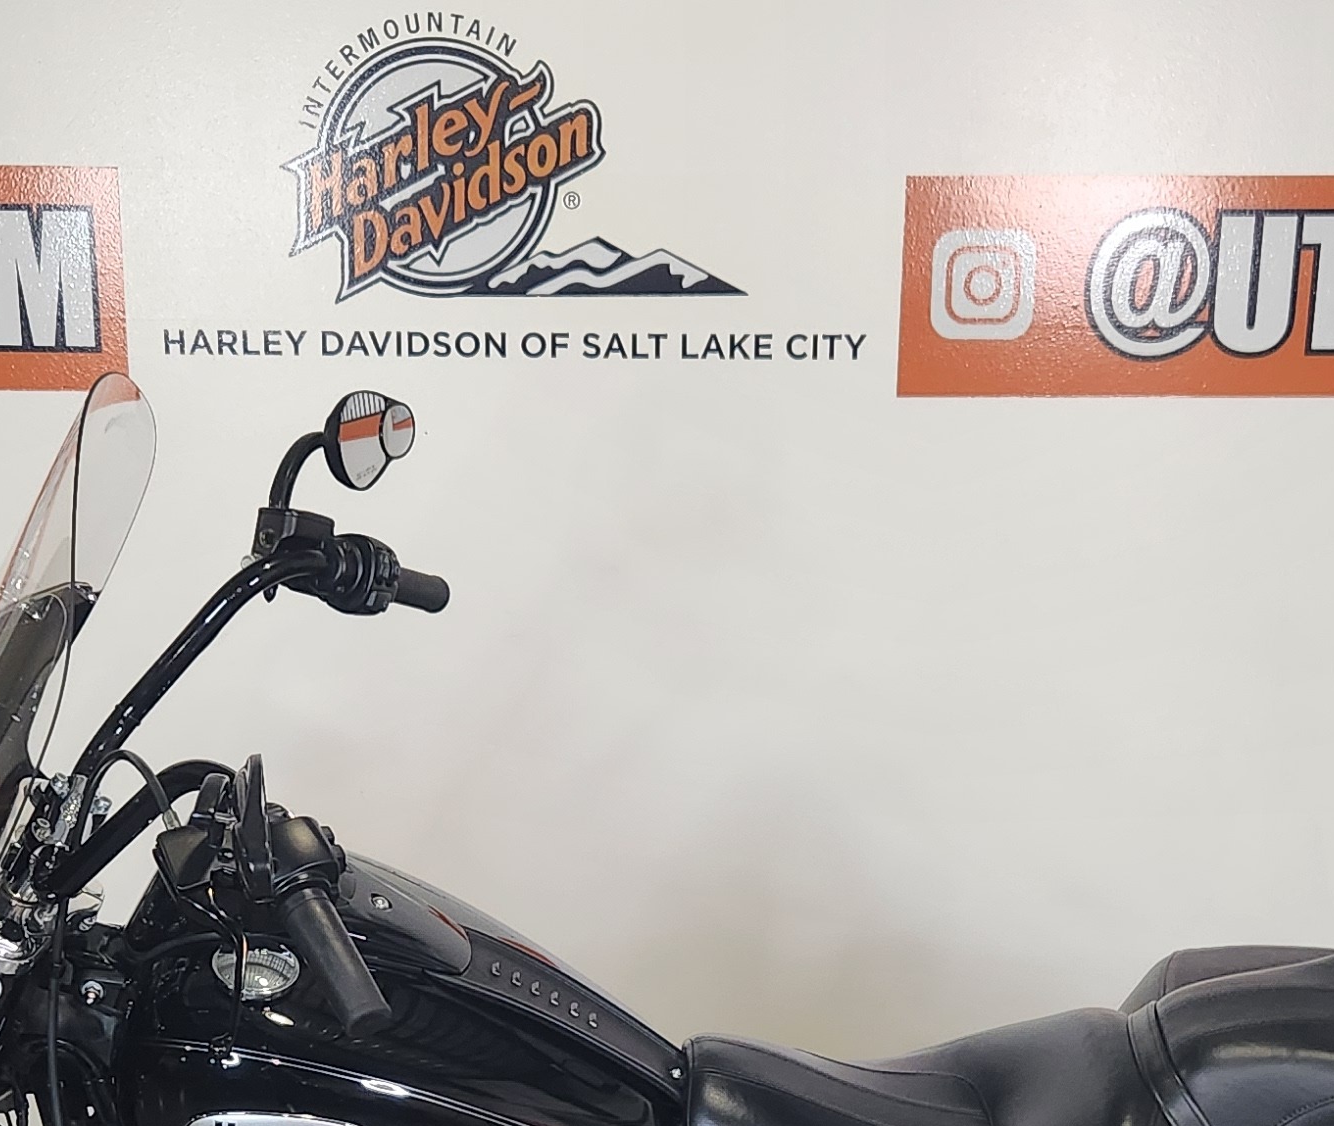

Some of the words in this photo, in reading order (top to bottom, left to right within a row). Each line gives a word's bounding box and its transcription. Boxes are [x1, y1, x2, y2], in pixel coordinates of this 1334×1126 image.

[299, 11, 517, 129] INTERMOUNTAIN
[352, 113, 589, 278] Davidson
[163, 329, 306, 357] HARLEY
[321, 330, 506, 358] DAVIDSON
[520, 331, 569, 358] OF
[582, 332, 667, 359] SALT
[681, 333, 772, 360] LAKE
[787, 333, 867, 360] CITY
